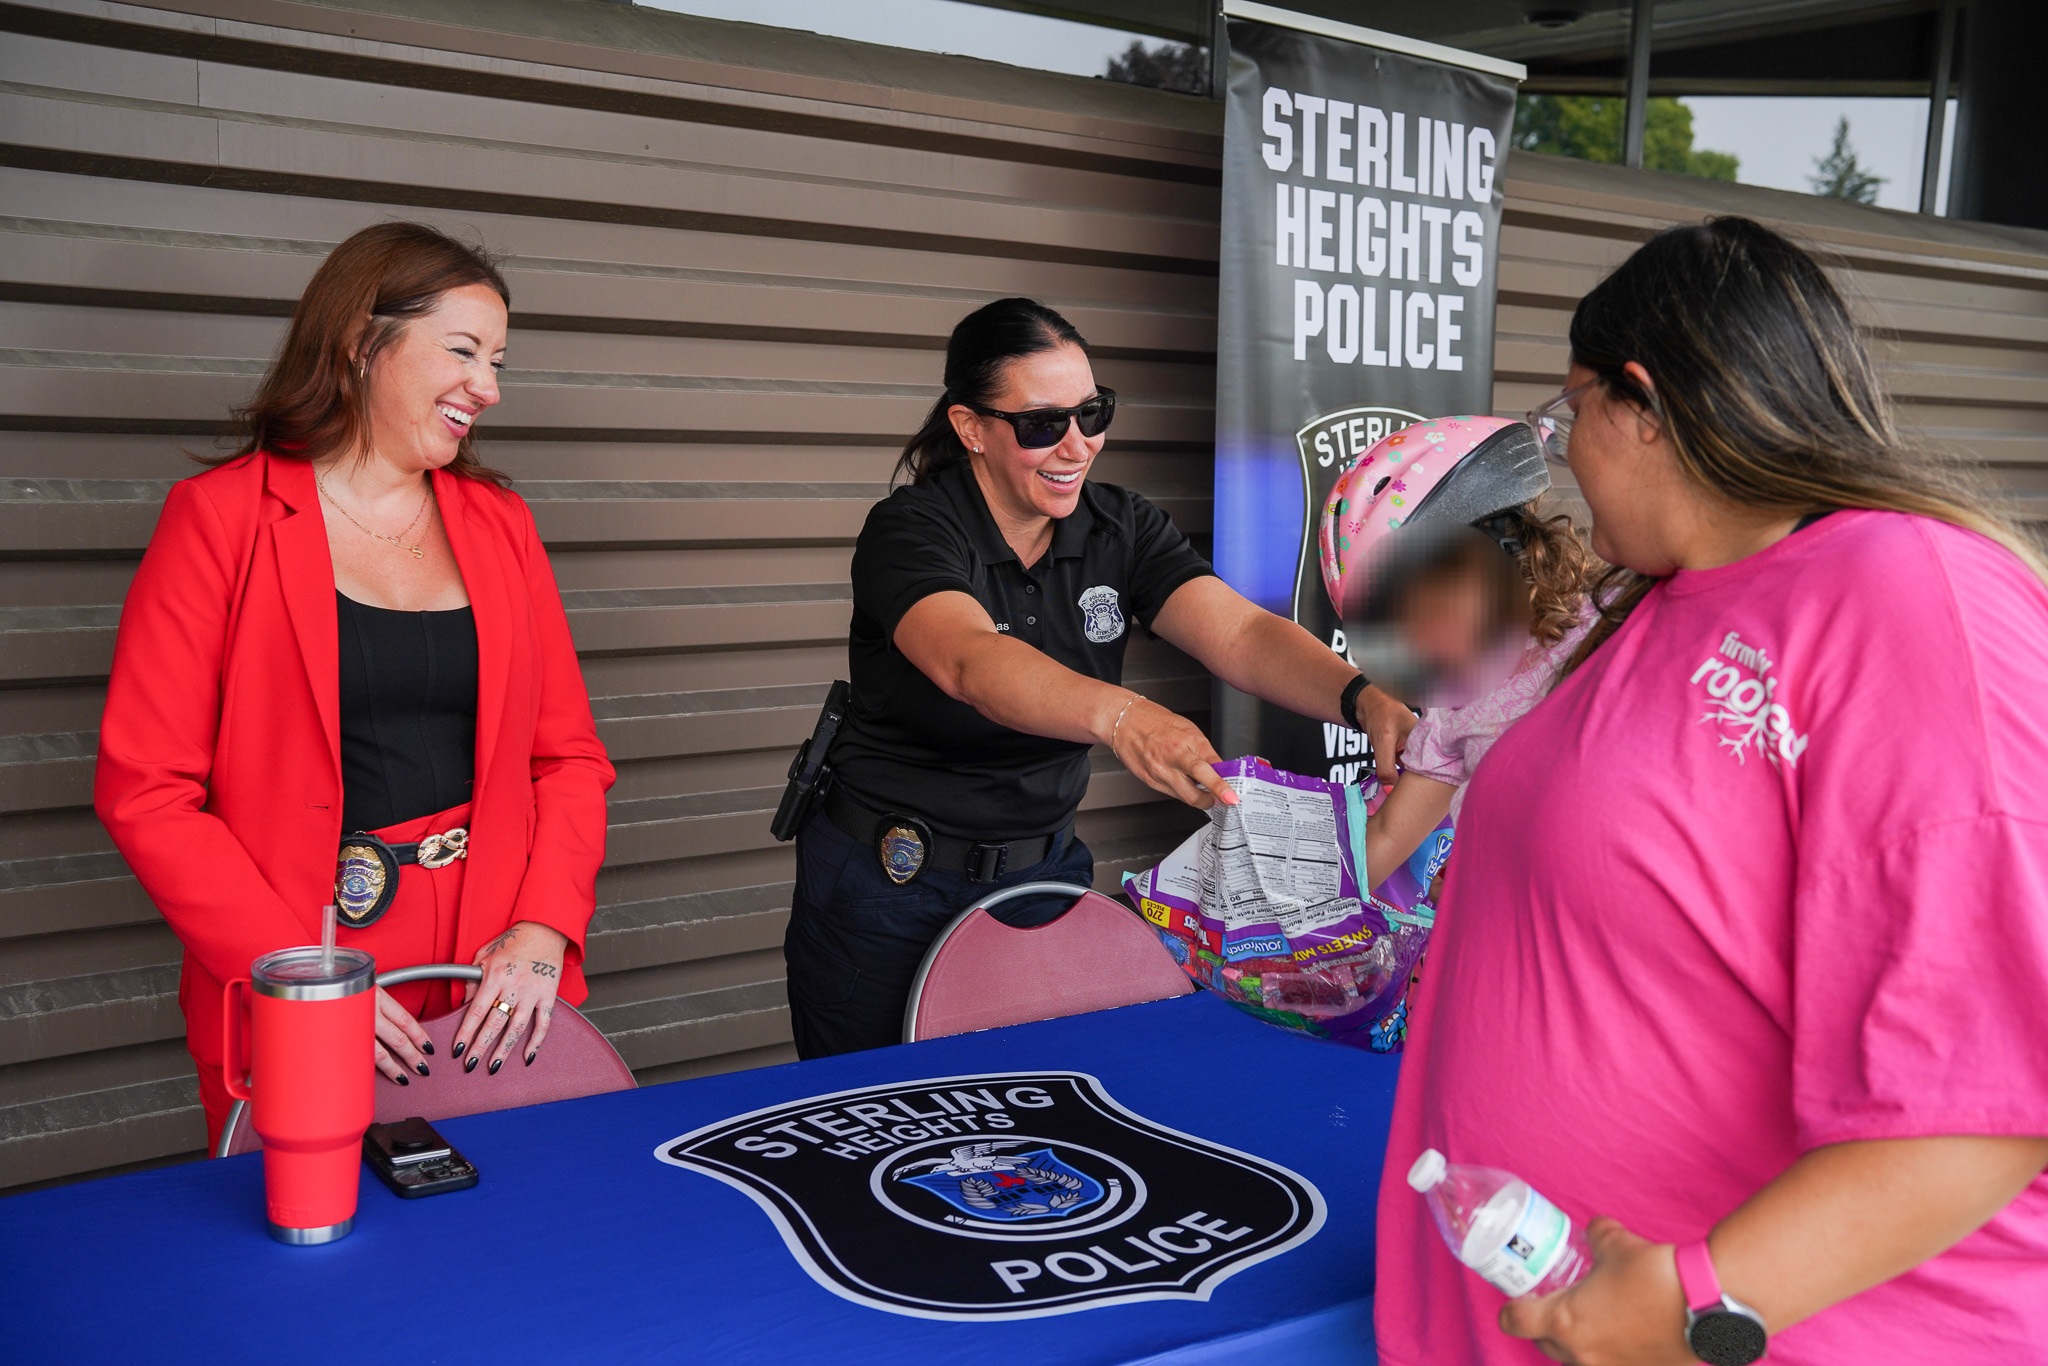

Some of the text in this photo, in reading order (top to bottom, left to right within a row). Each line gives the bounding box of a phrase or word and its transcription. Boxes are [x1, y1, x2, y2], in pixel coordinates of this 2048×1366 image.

[1261, 86, 1496, 204] STERLING
[1275, 182, 1483, 288] HEIGHTS
[1293, 278, 1464, 372] POLICE
[1719, 631, 1773, 680] firmly
[1146, 900, 1165, 911] PIECES
[1147, 907, 1164, 922] 270
[1229, 894, 1242, 903] 90
[1292, 946, 1318, 962] MIX
[1319, 925, 1373, 955] SWEETS
[734, 1086, 1055, 1160] STERLING
[821, 1112, 1016, 1161] HEIGHTS
[990, 1210, 1254, 1294] POLICE
